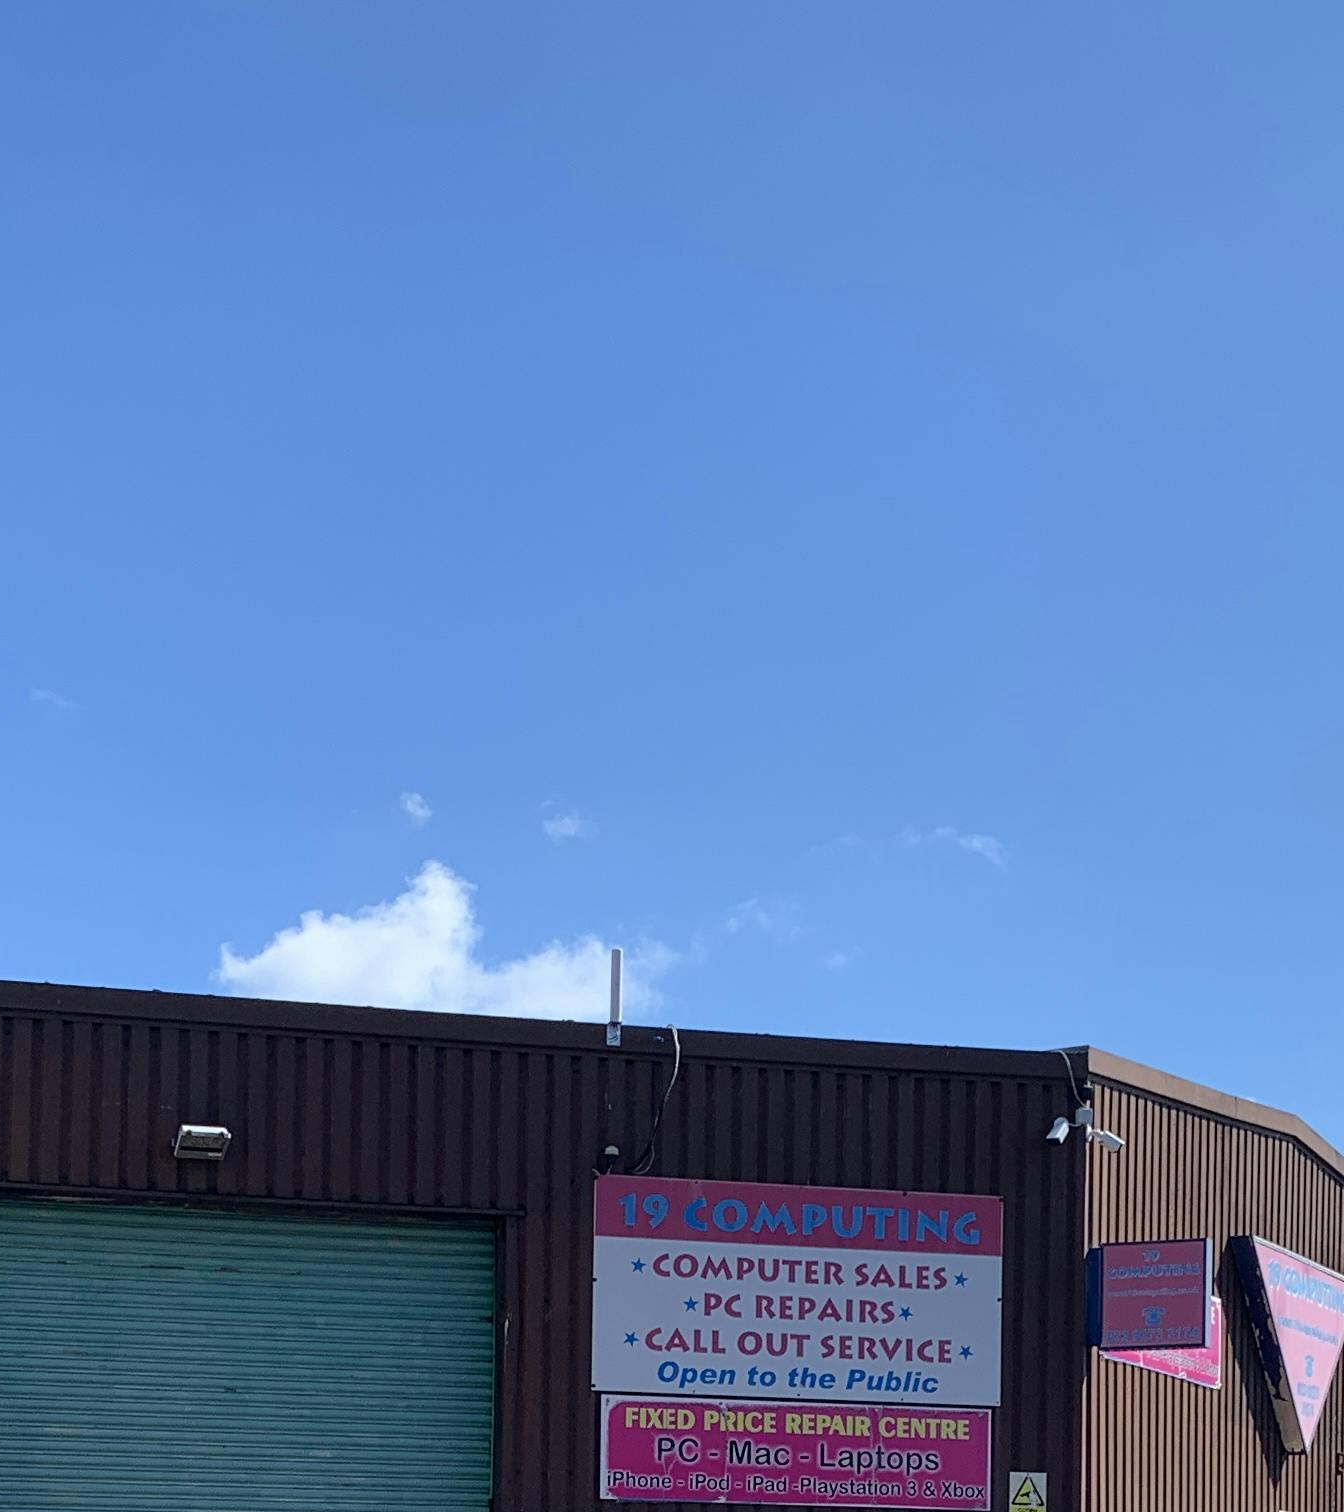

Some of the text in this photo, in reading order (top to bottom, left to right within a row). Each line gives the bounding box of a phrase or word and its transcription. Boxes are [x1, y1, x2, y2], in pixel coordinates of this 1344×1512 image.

[618, 1193, 981, 1245] 19 COMPUTING
[652, 1253, 948, 1290] COMPUTER SALES
[703, 1292, 895, 1325] PC REPAIRS
[644, 1327, 952, 1364] CALL OUT SERVICE
[657, 1361, 939, 1394] Open to the Public
[625, 1407, 970, 1441] FIXED PRICE REPAIR CENTRE
[657, 1437, 699, 1463] PC
[728, 1440, 790, 1466] Mac
[819, 1443, 940, 1476] Laptops
[607, 1470, 672, 1489] iPhone
[689, 1473, 730, 1490] iPod
[747, 1475, 787, 1492] iPad
[906, 1481, 917, 1497] 3
[923, 1481, 936, 1498] &
[941, 1482, 985, 1499] Xbox
